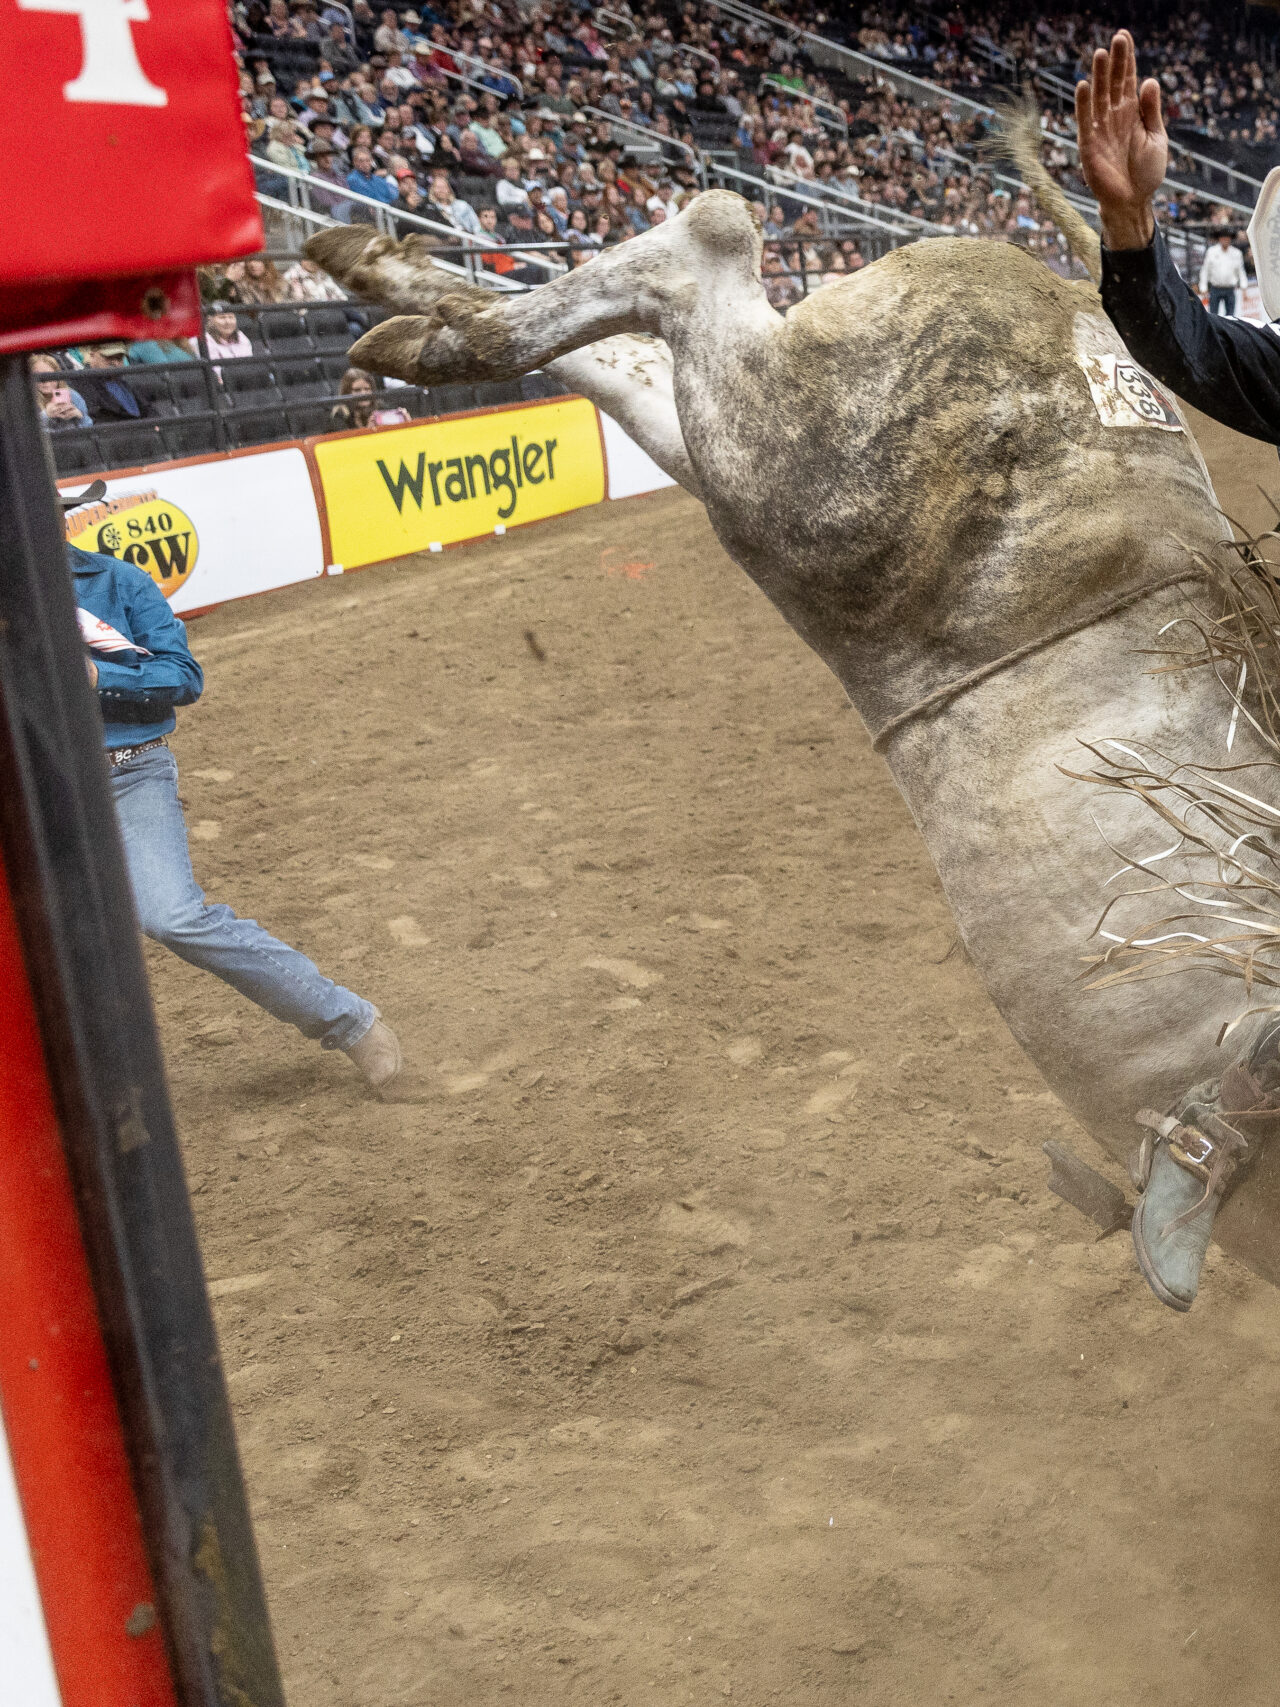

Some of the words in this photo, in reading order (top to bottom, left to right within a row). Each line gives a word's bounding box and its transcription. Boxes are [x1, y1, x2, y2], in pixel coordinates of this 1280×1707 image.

[1119, 370, 1161, 416] 338
[376, 435, 557, 519] Wrangler
[126, 512, 173, 539] 840
